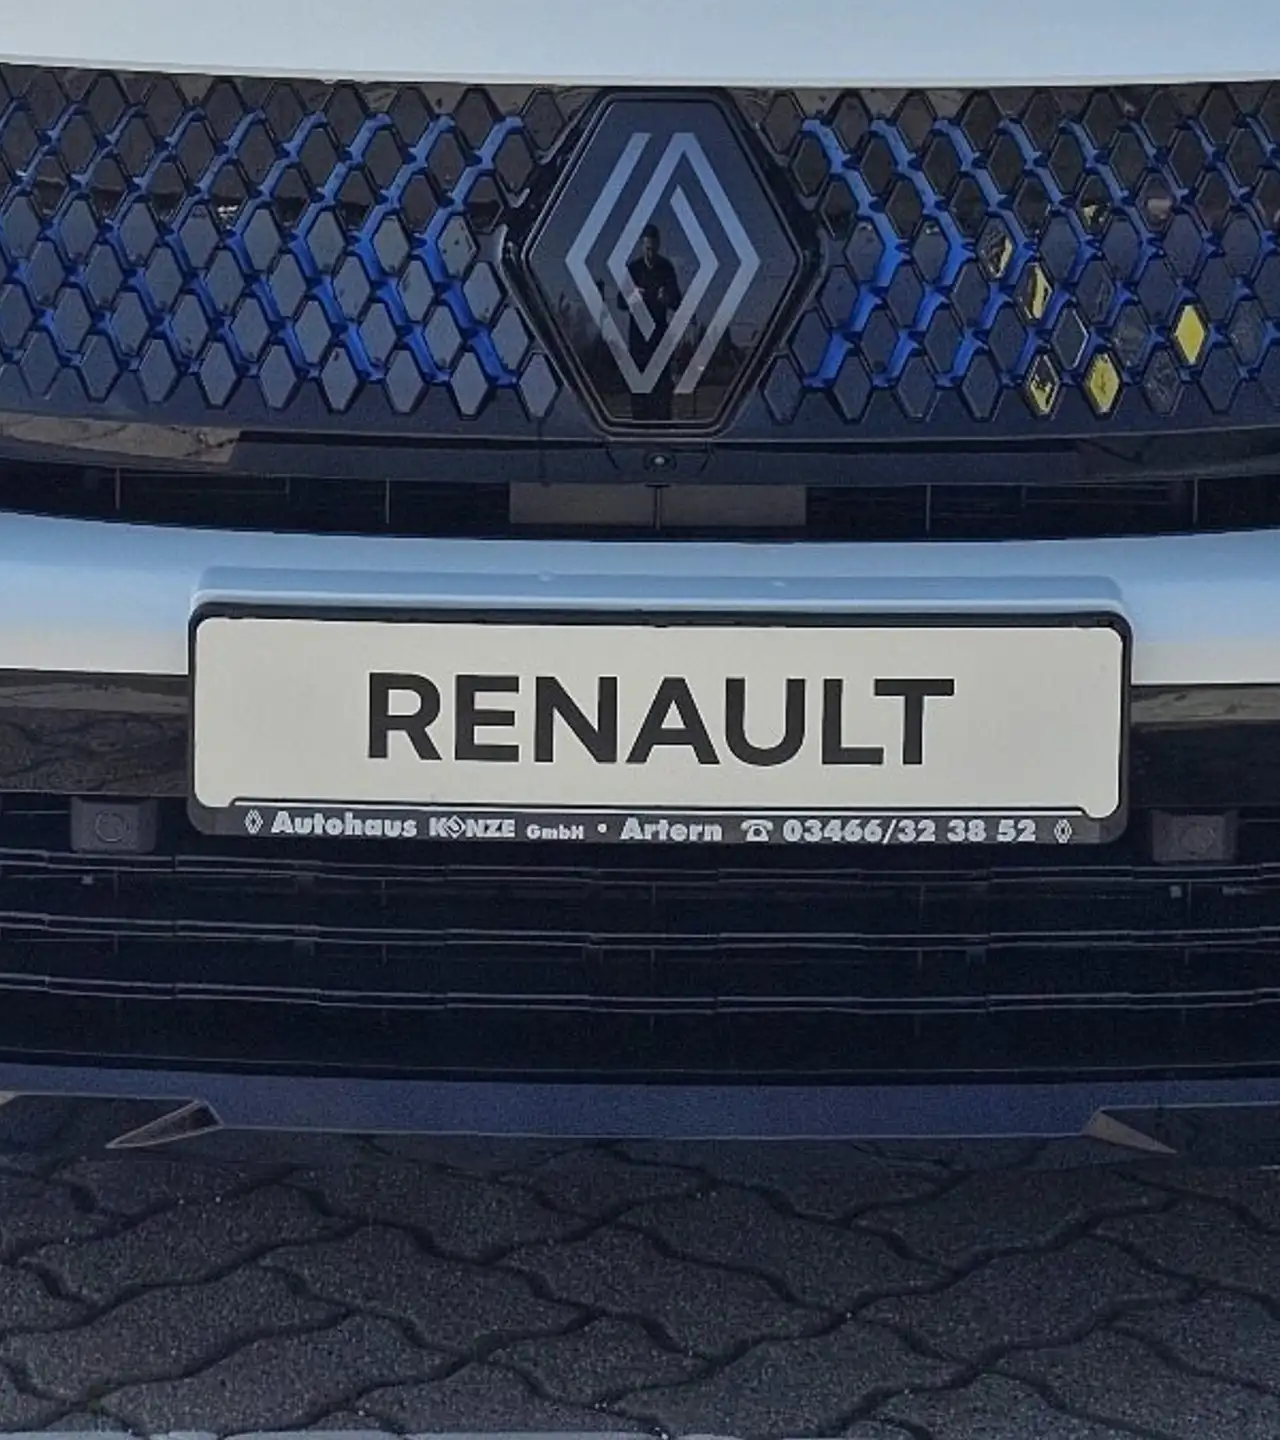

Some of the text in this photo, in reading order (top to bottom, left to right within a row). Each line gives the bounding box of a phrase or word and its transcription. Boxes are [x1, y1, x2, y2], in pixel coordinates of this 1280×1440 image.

[368, 672, 955, 766] RENAULT
[271, 810, 418, 837] Autohaus
[526, 823, 584, 840] GmbH
[620, 818, 722, 841] Artern
[782, 819, 936, 843] 03466/32
[947, 820, 986, 841] 38
[997, 820, 1037, 841] 52
